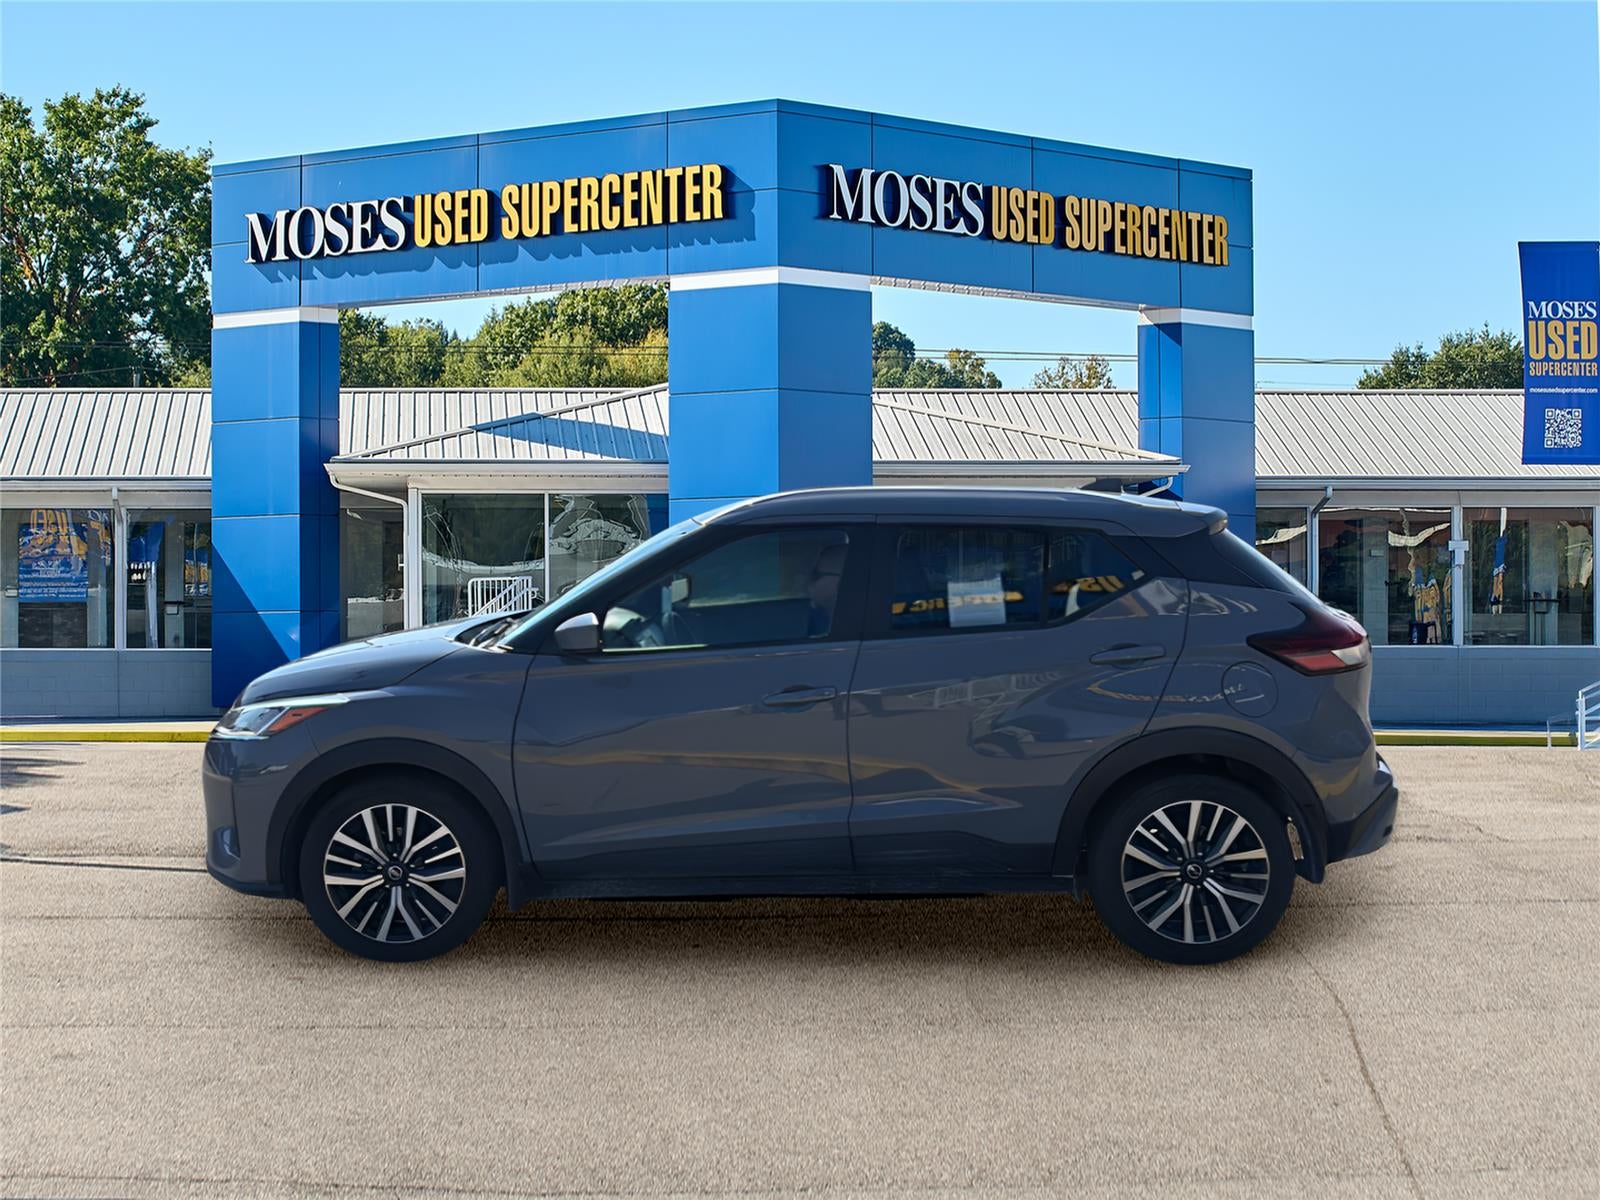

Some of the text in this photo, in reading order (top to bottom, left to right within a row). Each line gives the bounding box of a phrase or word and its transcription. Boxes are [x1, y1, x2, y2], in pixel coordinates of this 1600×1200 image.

[244, 164, 723, 263] MOSES USED SUPERCENTER
[829, 164, 1228, 266] MOSES USED SUPERCENTER
[1527, 301, 1597, 319] MOSES
[1528, 320, 1598, 360] USED
[1529, 362, 1598, 376] SUPERCENTER
